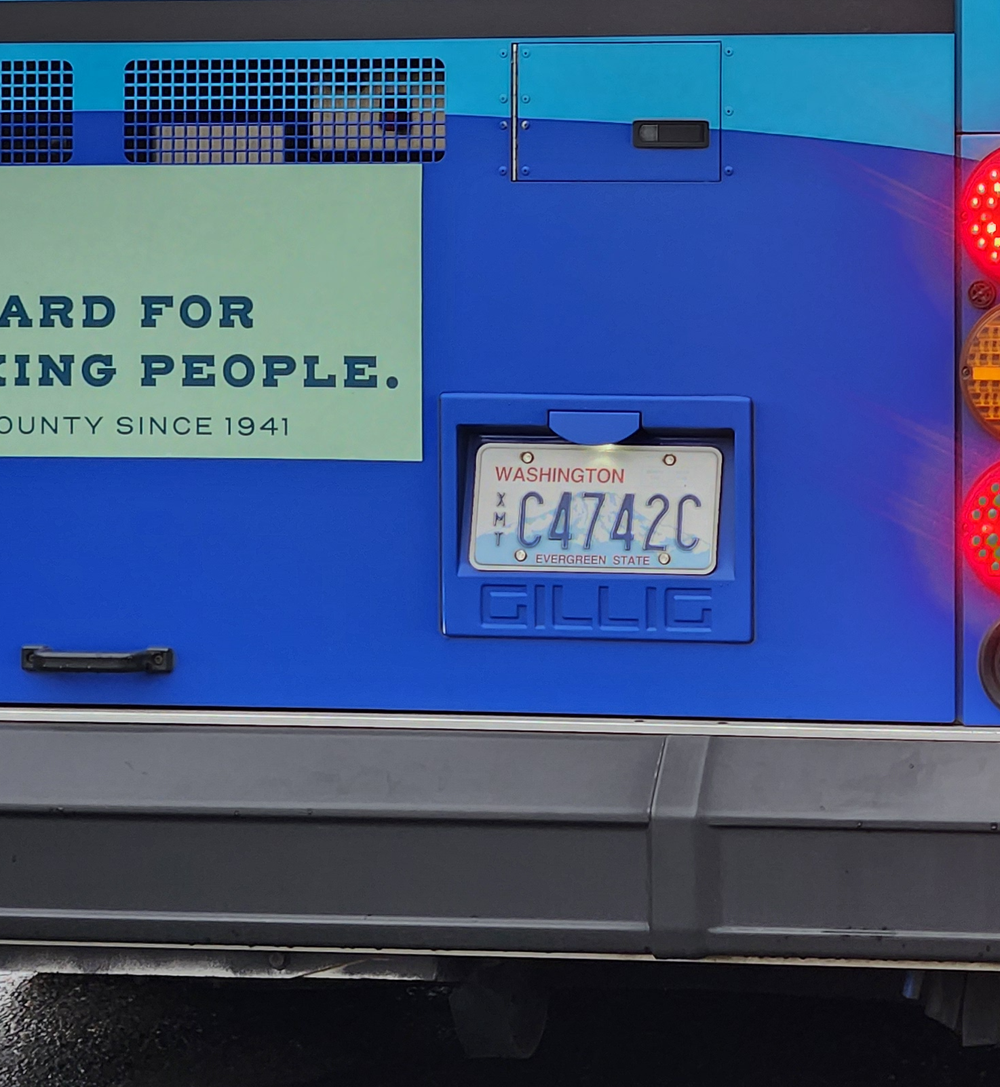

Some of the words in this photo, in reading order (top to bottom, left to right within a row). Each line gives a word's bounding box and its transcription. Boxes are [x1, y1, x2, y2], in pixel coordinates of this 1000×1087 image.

[140, 294, 254, 329] FOR
[0, 353, 117, 388] ING
[140, 353, 399, 390] PEOPLE.
[0, 415, 104, 435] OUNTY
[116, 416, 213, 436] SINCE
[225, 416, 290, 436] 1941
[495, 466, 626, 484] WASHINGTON
[517, 490, 702, 551] C4742C
[535, 554, 607, 565] EVERGREEN
[613, 556, 651, 566] STATE
[479, 583, 713, 633] GILLIG
